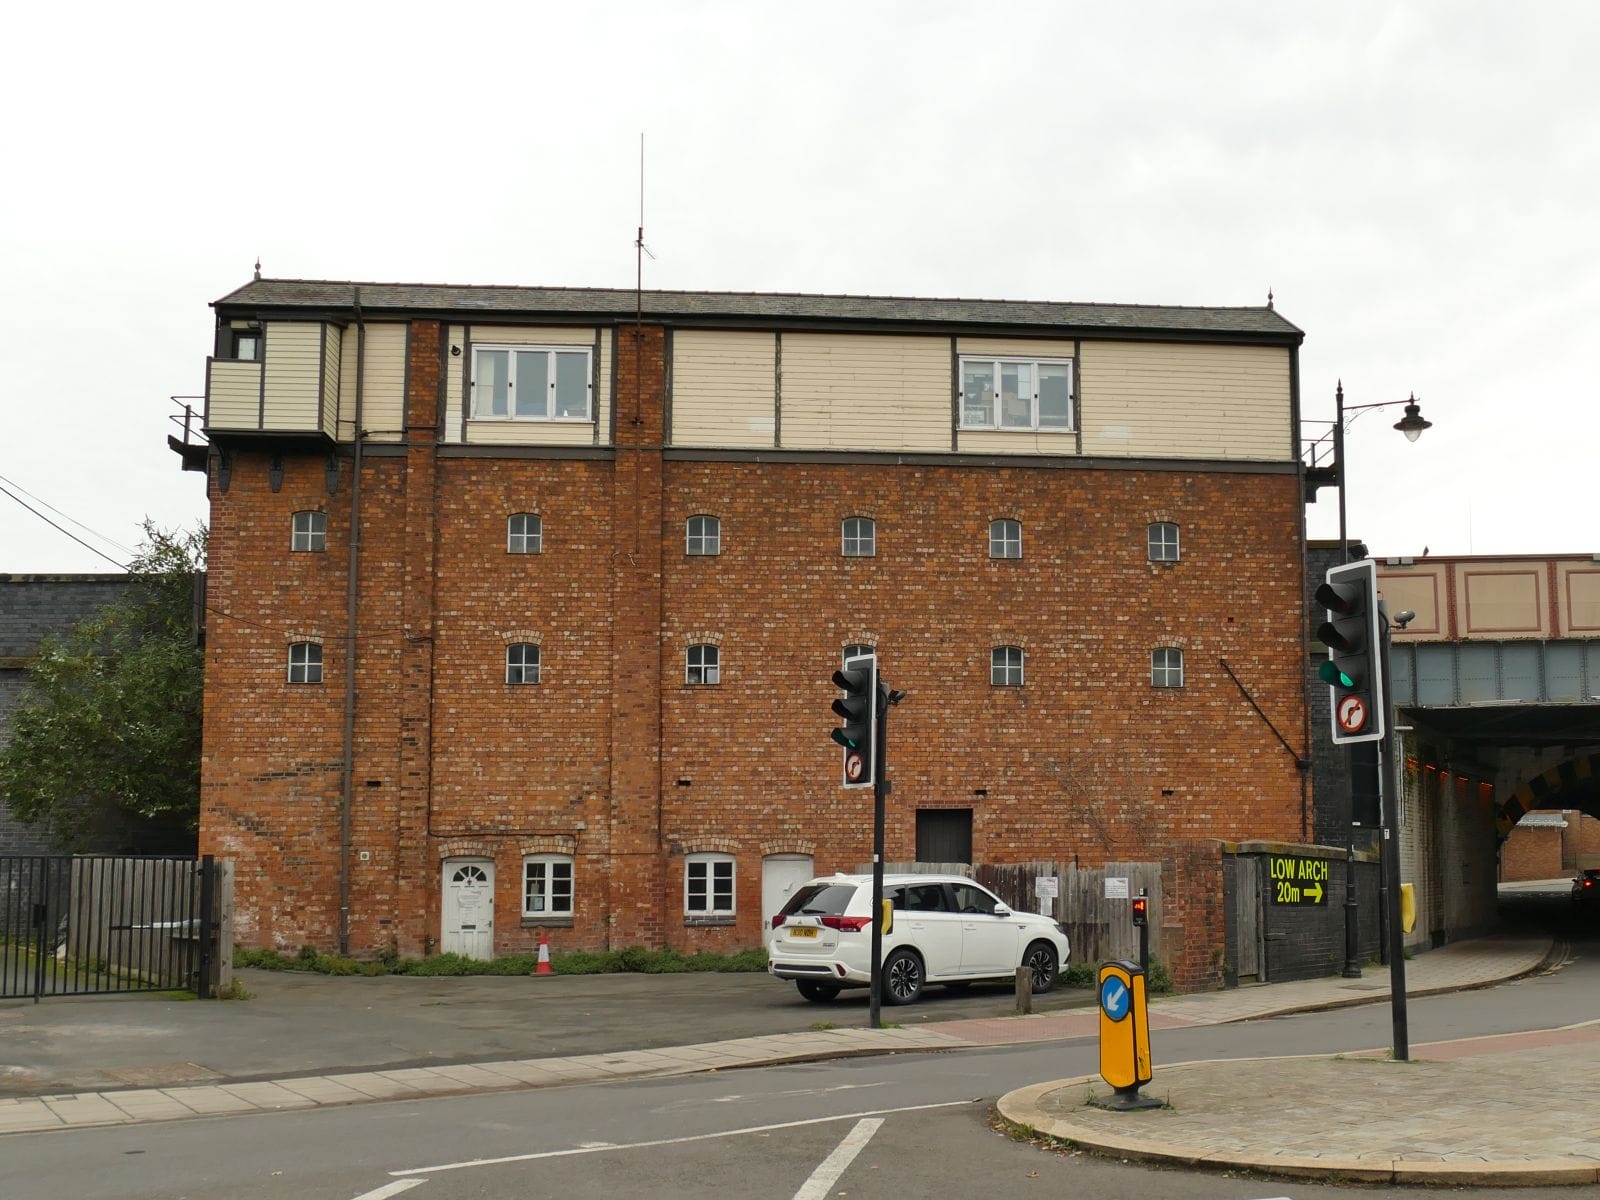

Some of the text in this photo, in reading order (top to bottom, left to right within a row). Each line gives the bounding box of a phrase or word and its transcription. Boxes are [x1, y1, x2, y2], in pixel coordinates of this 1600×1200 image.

[1270, 858, 1328, 880] LOW ARCH
[1277, 881, 1300, 903] 20m
